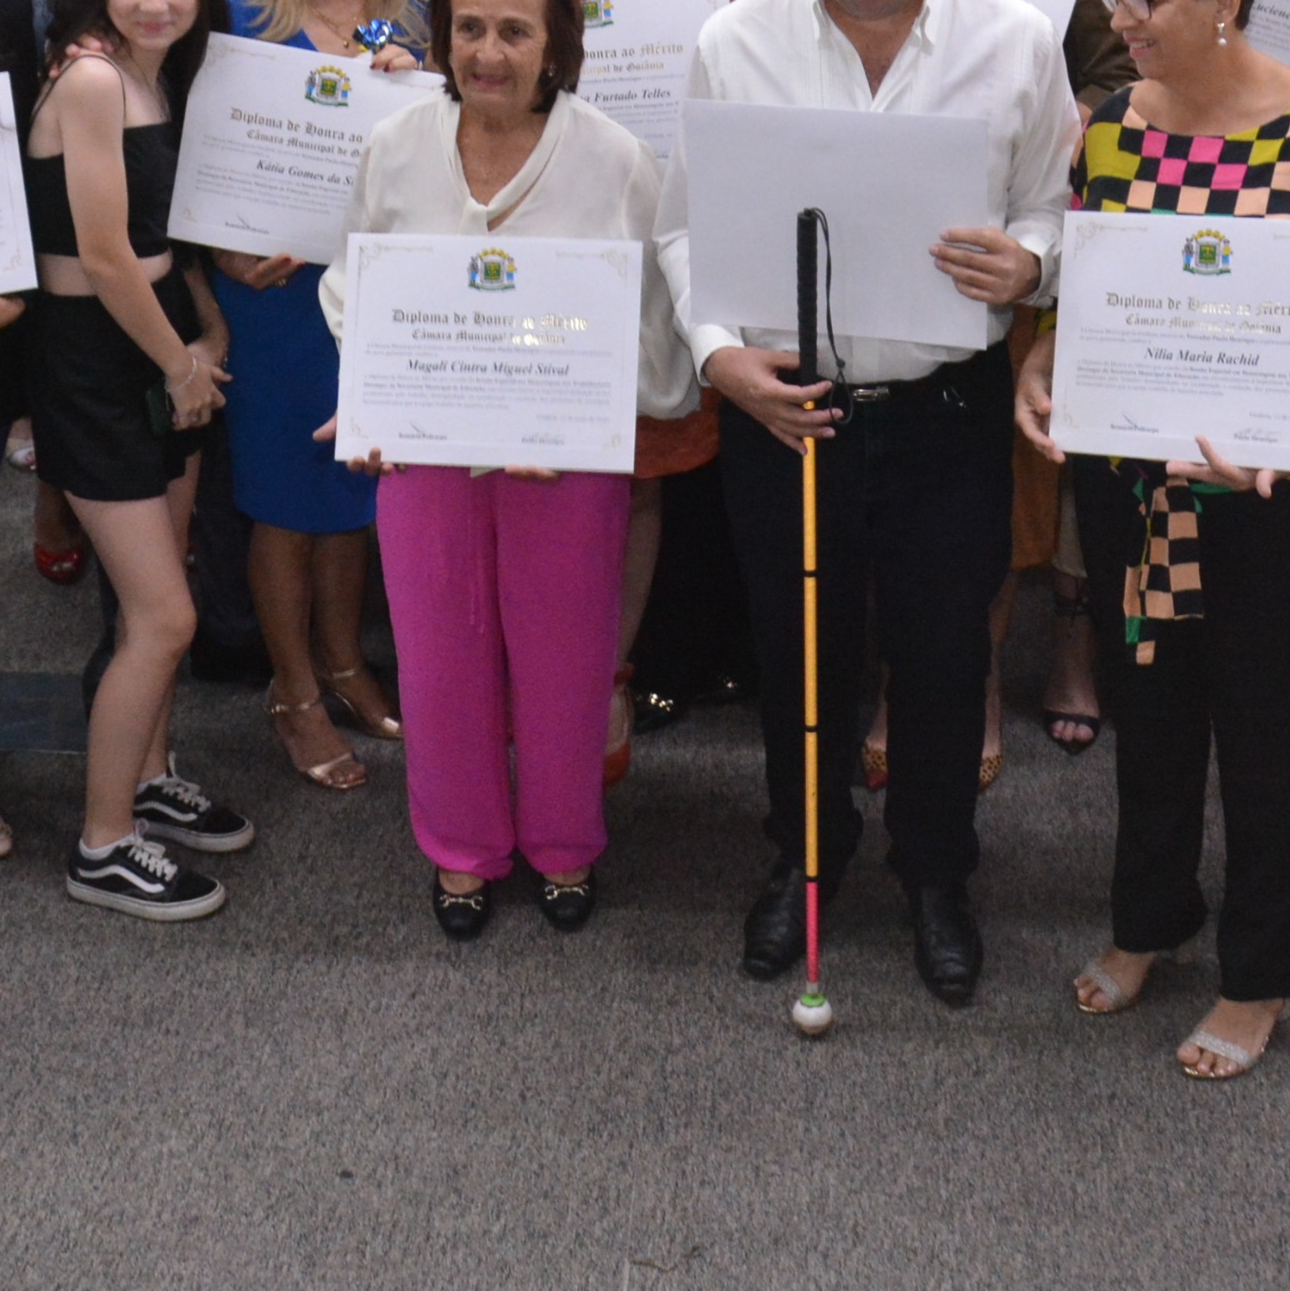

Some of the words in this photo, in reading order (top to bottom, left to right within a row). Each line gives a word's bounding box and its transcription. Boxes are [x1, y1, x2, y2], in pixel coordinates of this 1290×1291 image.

[622, 47, 635, 58] ao
[639, 42, 684, 58] Mérito
[594, 89, 638, 103] Furtado
[642, 88, 671, 100] Telles
[230, 107, 283, 130] Diploma
[286, 119, 300, 133] de
[348, 132, 363, 144] ao
[246, 129, 284, 146] Câmara
[286, 135, 335, 157] Municipal
[338, 145, 348, 157] de
[288, 166, 324, 183] Gomes
[327, 172, 341, 184] da
[1105, 292, 1163, 312] Diploma
[1167, 295, 1182, 311] de
[391, 308, 449, 326] Diploma
[453, 310, 467, 324] de
[411, 330, 452, 342] Câmara
[1178, 349, 1213, 364] Maria
[1216, 351, 1260, 367] Rachid
[405, 359, 447, 374] Magali
[450, 361, 489, 374] Cintra
[491, 362, 533, 377] Miguel
[536, 362, 569, 376] Stival
